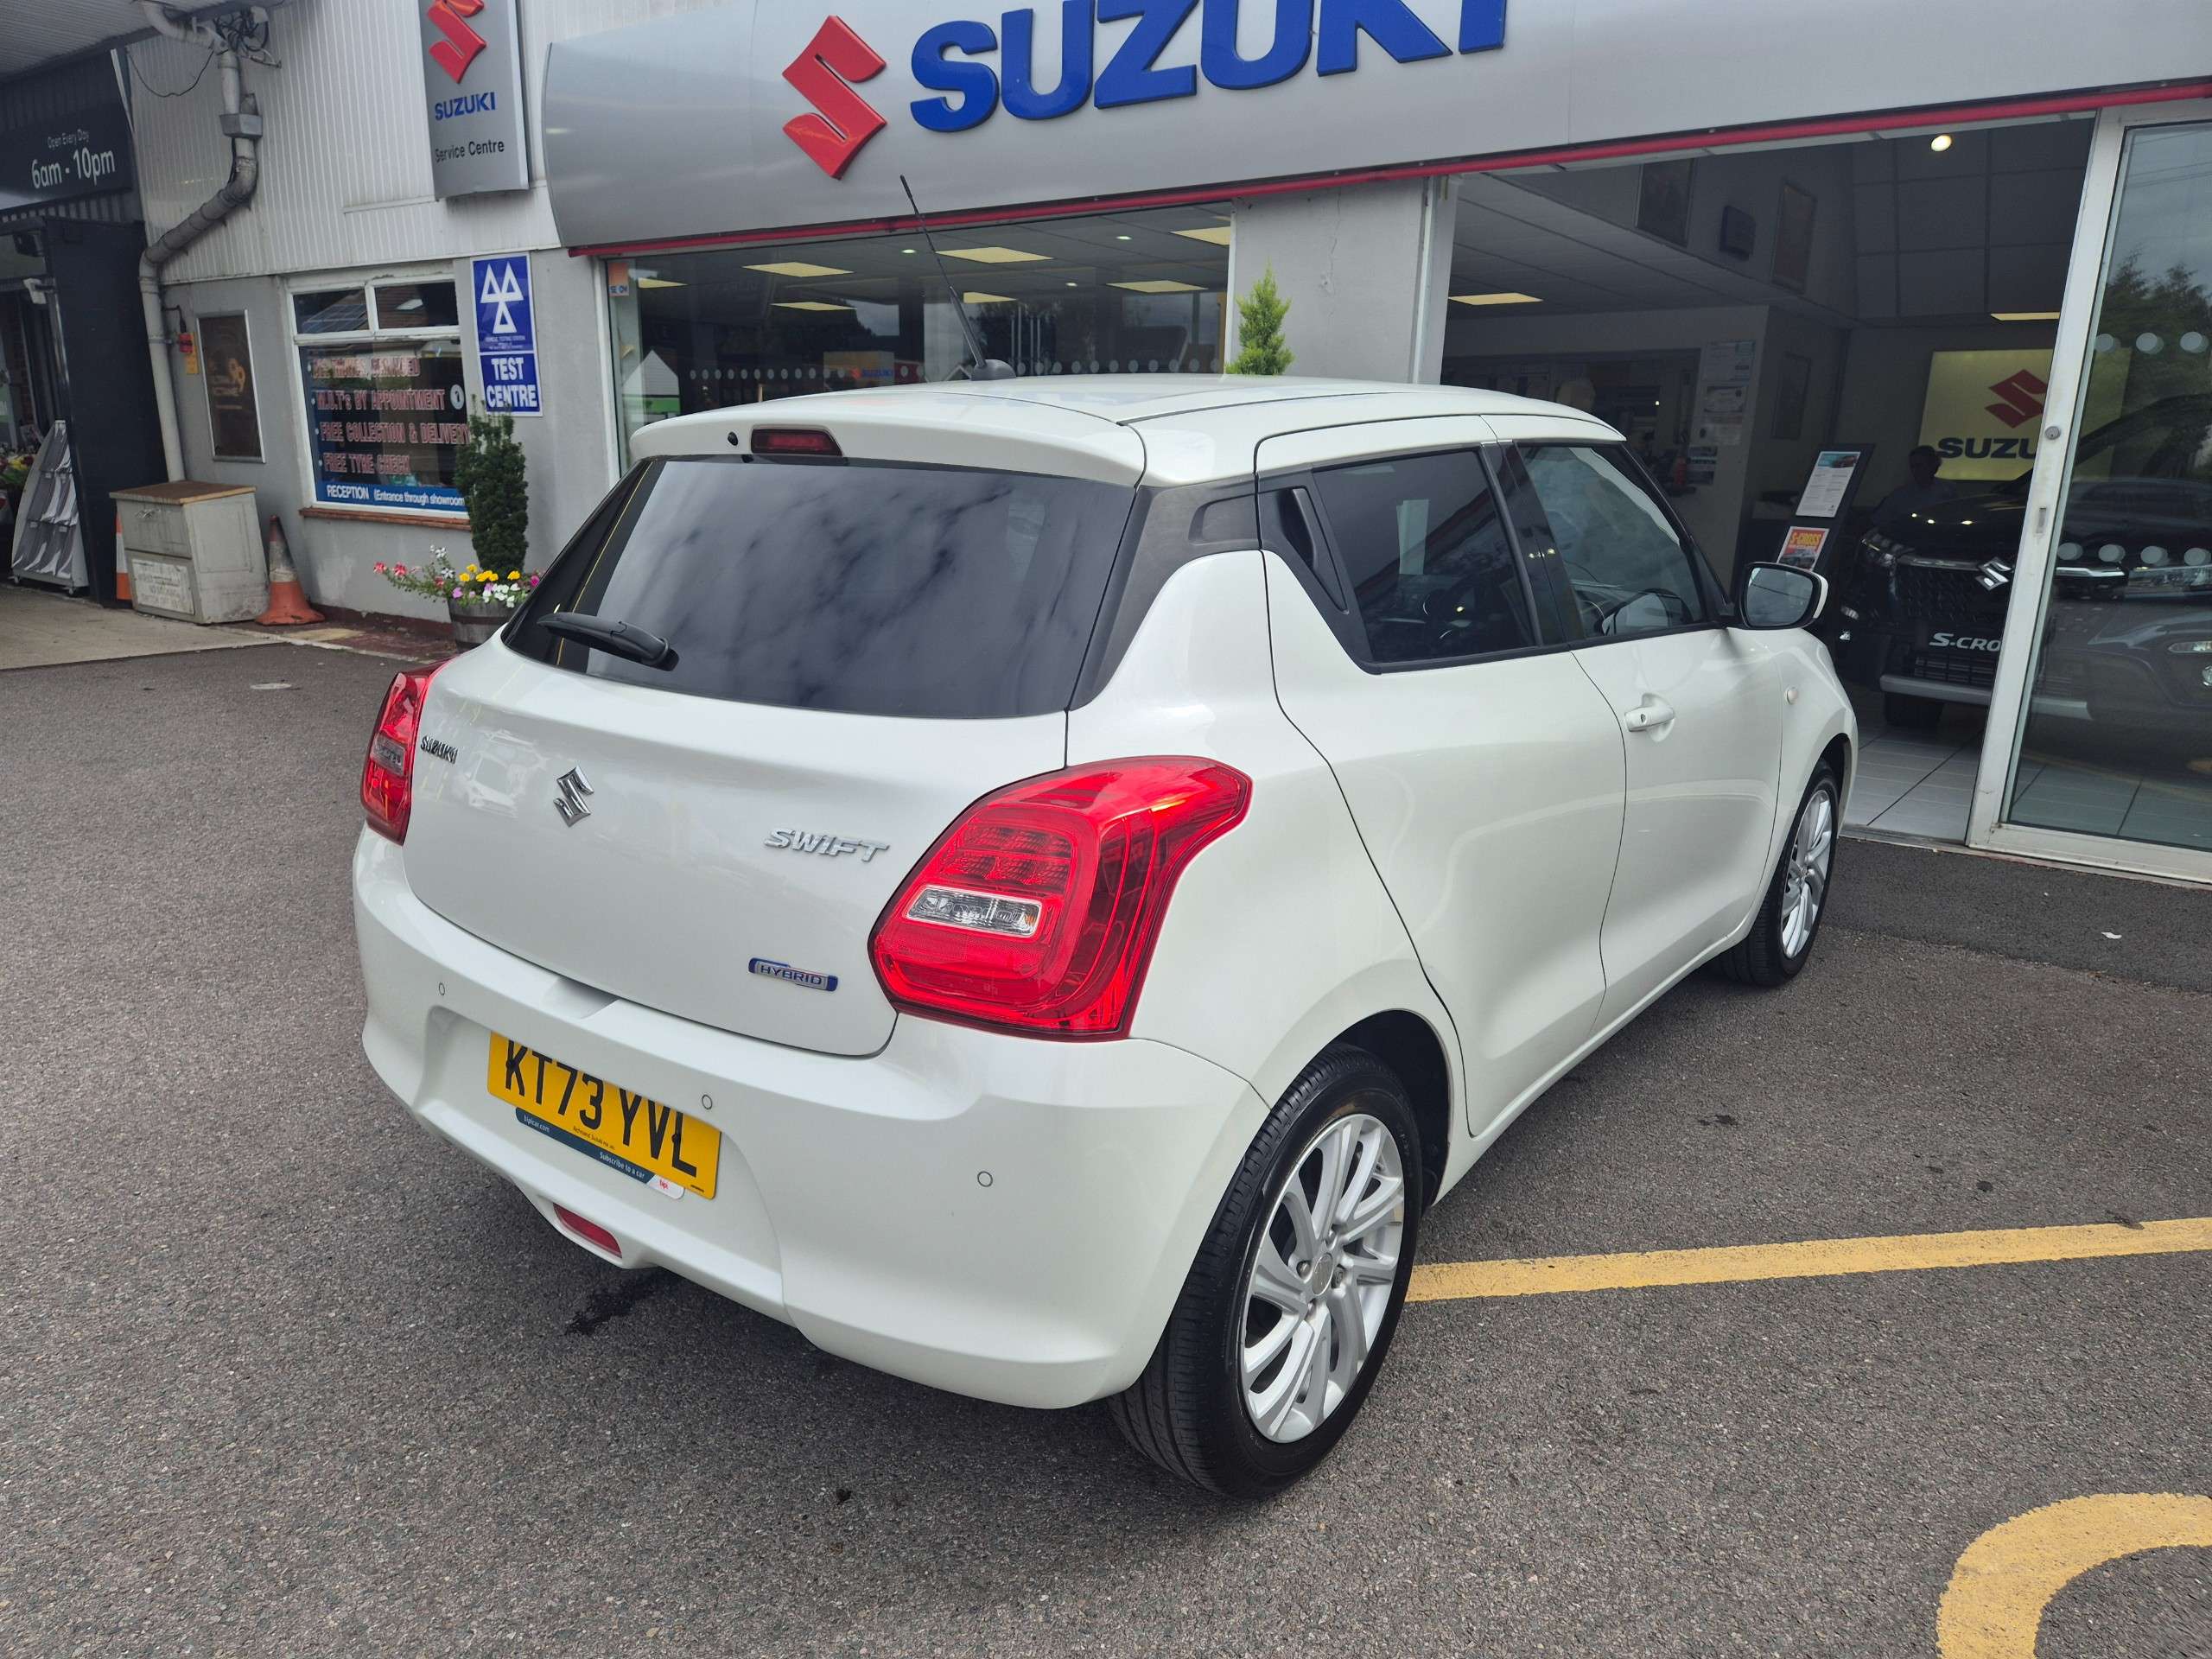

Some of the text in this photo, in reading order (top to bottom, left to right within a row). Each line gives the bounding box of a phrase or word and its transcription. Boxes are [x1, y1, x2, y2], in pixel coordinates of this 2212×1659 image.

[435, 92, 496, 121] SUZUKI
[435, 139, 505, 163] Service Centre
[31, 159, 62, 188] 6am
[73, 147, 115, 186] 10pm
[491, 357, 524, 380] TEST
[354, 391, 367, 410] BY
[371, 390, 445, 410] APPOINTMENT
[486, 384, 537, 408] CENTRE
[320, 421, 470, 446] FREE COLLECTION & DELIVERY
[1937, 437, 2037, 460] SUZU
[322, 452, 410, 475] FREE TYRE CHECK
[326, 484, 370, 499] RECEPTION
[373, 489, 404, 503] (Entrance
[404, 491, 429, 506] through
[1929, 632, 2001, 652] S-CRO
[420, 735, 458, 765] SUZUKI
[764, 827, 890, 862] SWIFT
[760, 964, 822, 986] HYBRID
[505, 1039, 696, 1178] KT73 YVL
[599, 1151, 625, 1169] Subscribe
[625, 1164, 632, 1173] to
[636, 1170, 645, 1179] car
